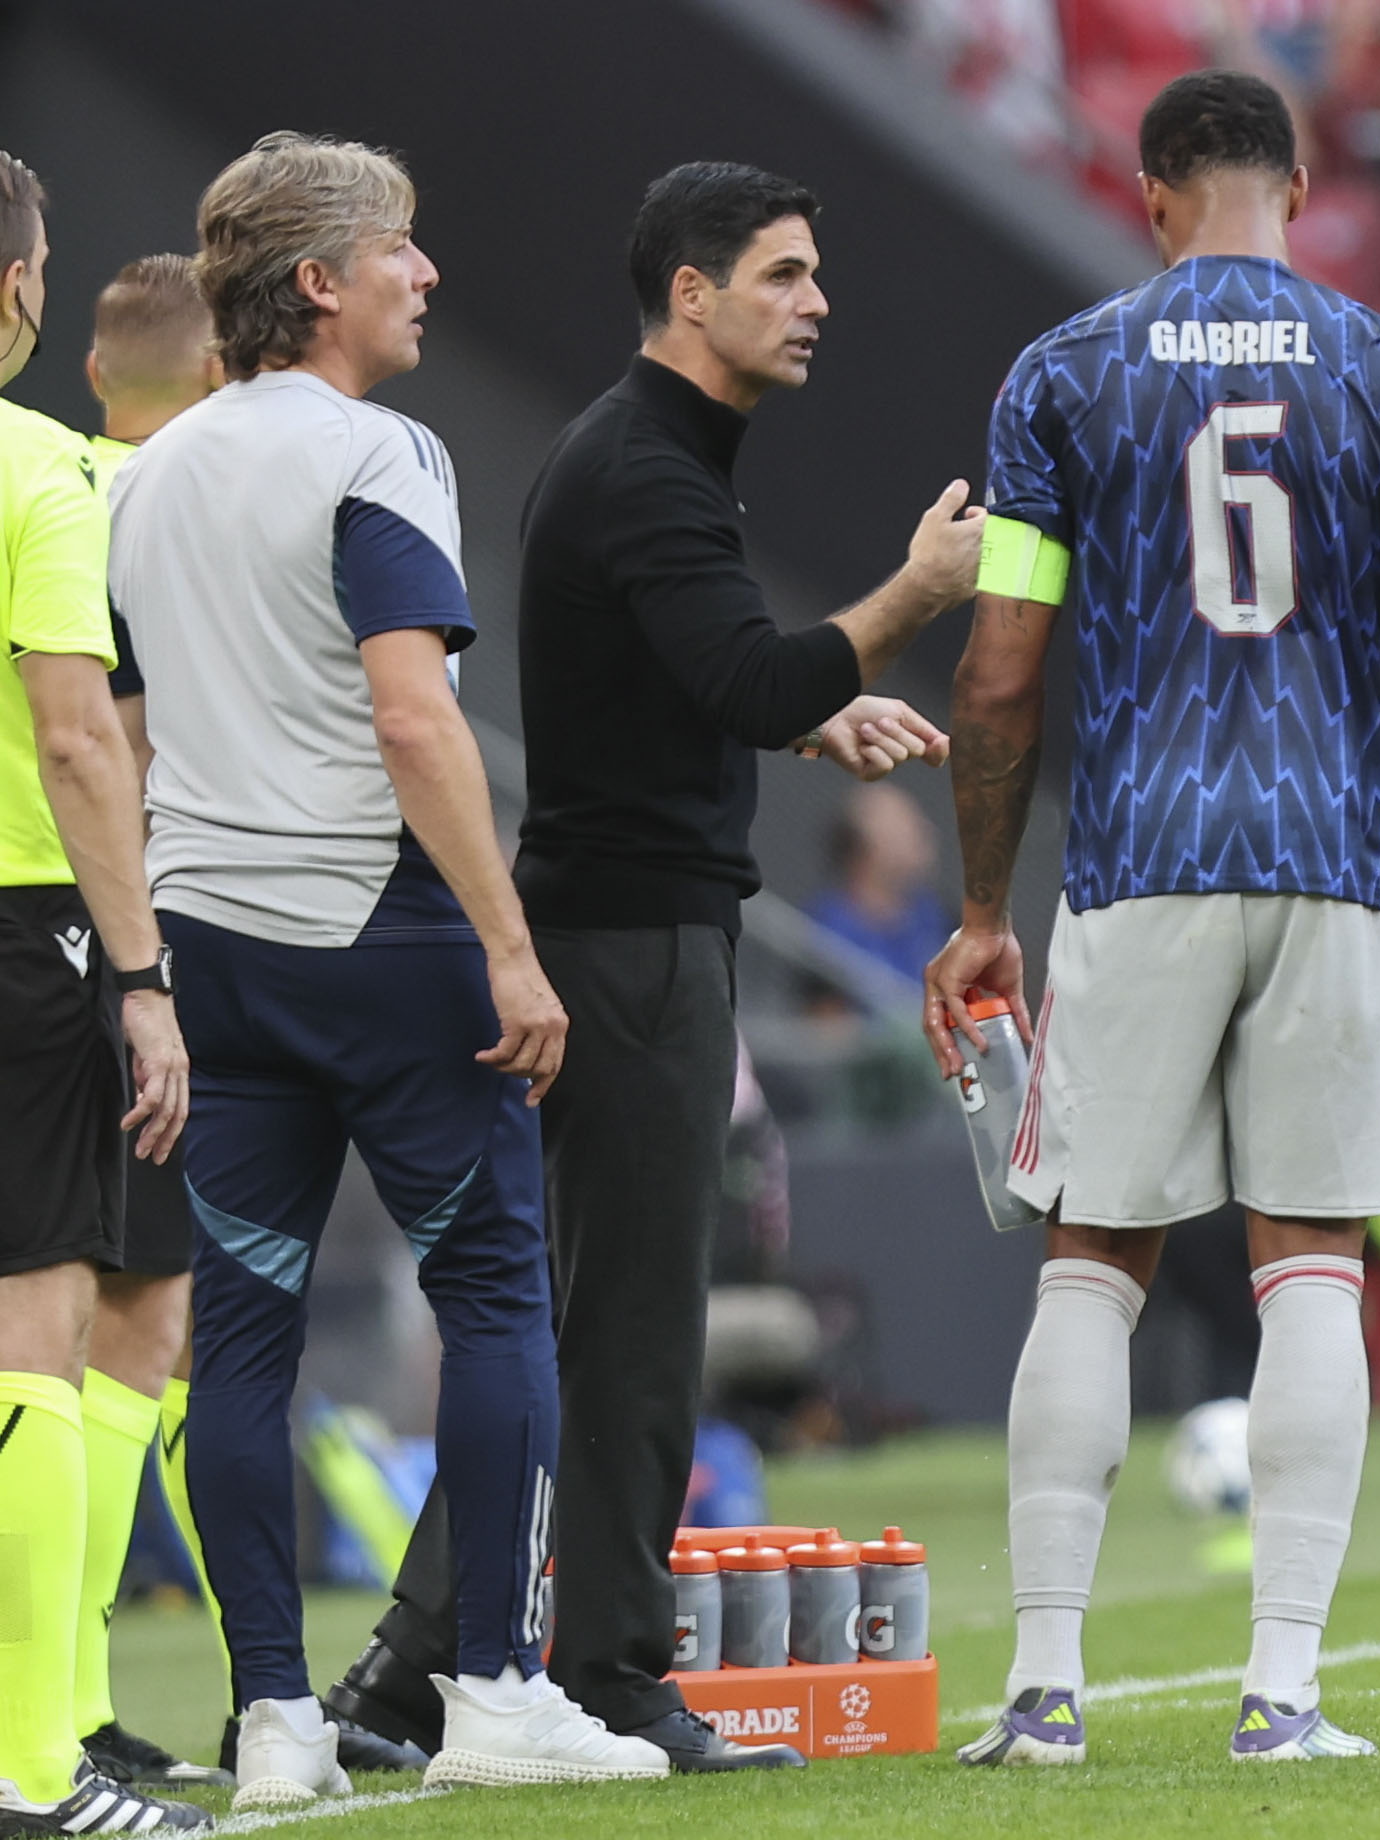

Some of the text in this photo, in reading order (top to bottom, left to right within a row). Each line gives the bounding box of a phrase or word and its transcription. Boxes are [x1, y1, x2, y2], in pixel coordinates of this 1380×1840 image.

[1149, 320, 1316, 366] GABRIEL
[1184, 401, 1300, 637] 6
[861, 1605, 897, 1653] G
[824, 1733, 888, 1745] CHAMPIONS
